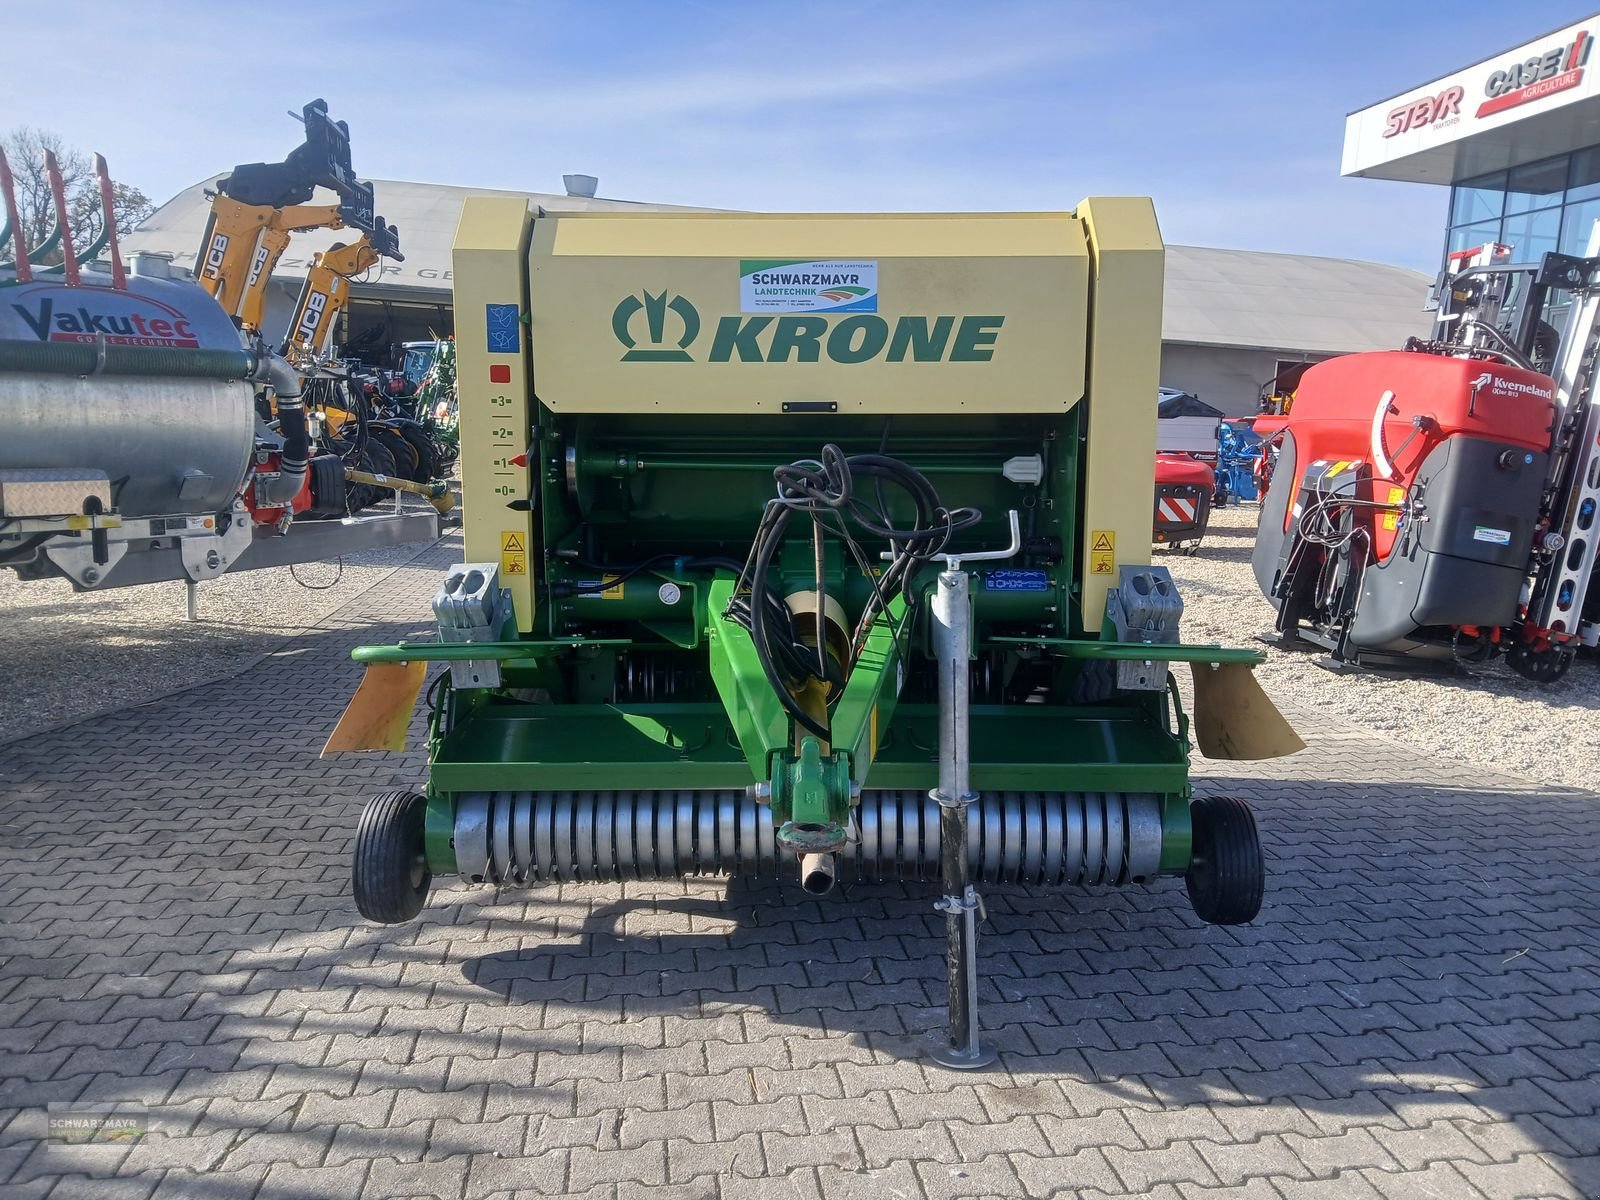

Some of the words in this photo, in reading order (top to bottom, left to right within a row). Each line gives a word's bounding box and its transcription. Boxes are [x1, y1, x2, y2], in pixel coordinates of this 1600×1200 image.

[1485, 47, 1563, 98] CASE
[1521, 72, 1576, 100] AGRICULTURE
[1382, 85, 1464, 138] STEYR
[1432, 117, 1460, 131] TRAKTOREN
[205, 233, 229, 280] JCB
[752, 273, 859, 285] SCHWARZMAYR
[755, 288, 816, 296] LANDTECHNIK
[11, 298, 196, 341] Vakutec
[298, 292, 326, 343] JCB
[77, 336, 177, 347] GÜE-TECHNIK
[707, 315, 1005, 365] KRONE
[1494, 377, 1552, 399] Kverneland
[498, 396, 505, 406] 3
[500, 428, 506, 438] 2
[501, 458, 506, 468] 1
[502, 485, 508, 496] 0
